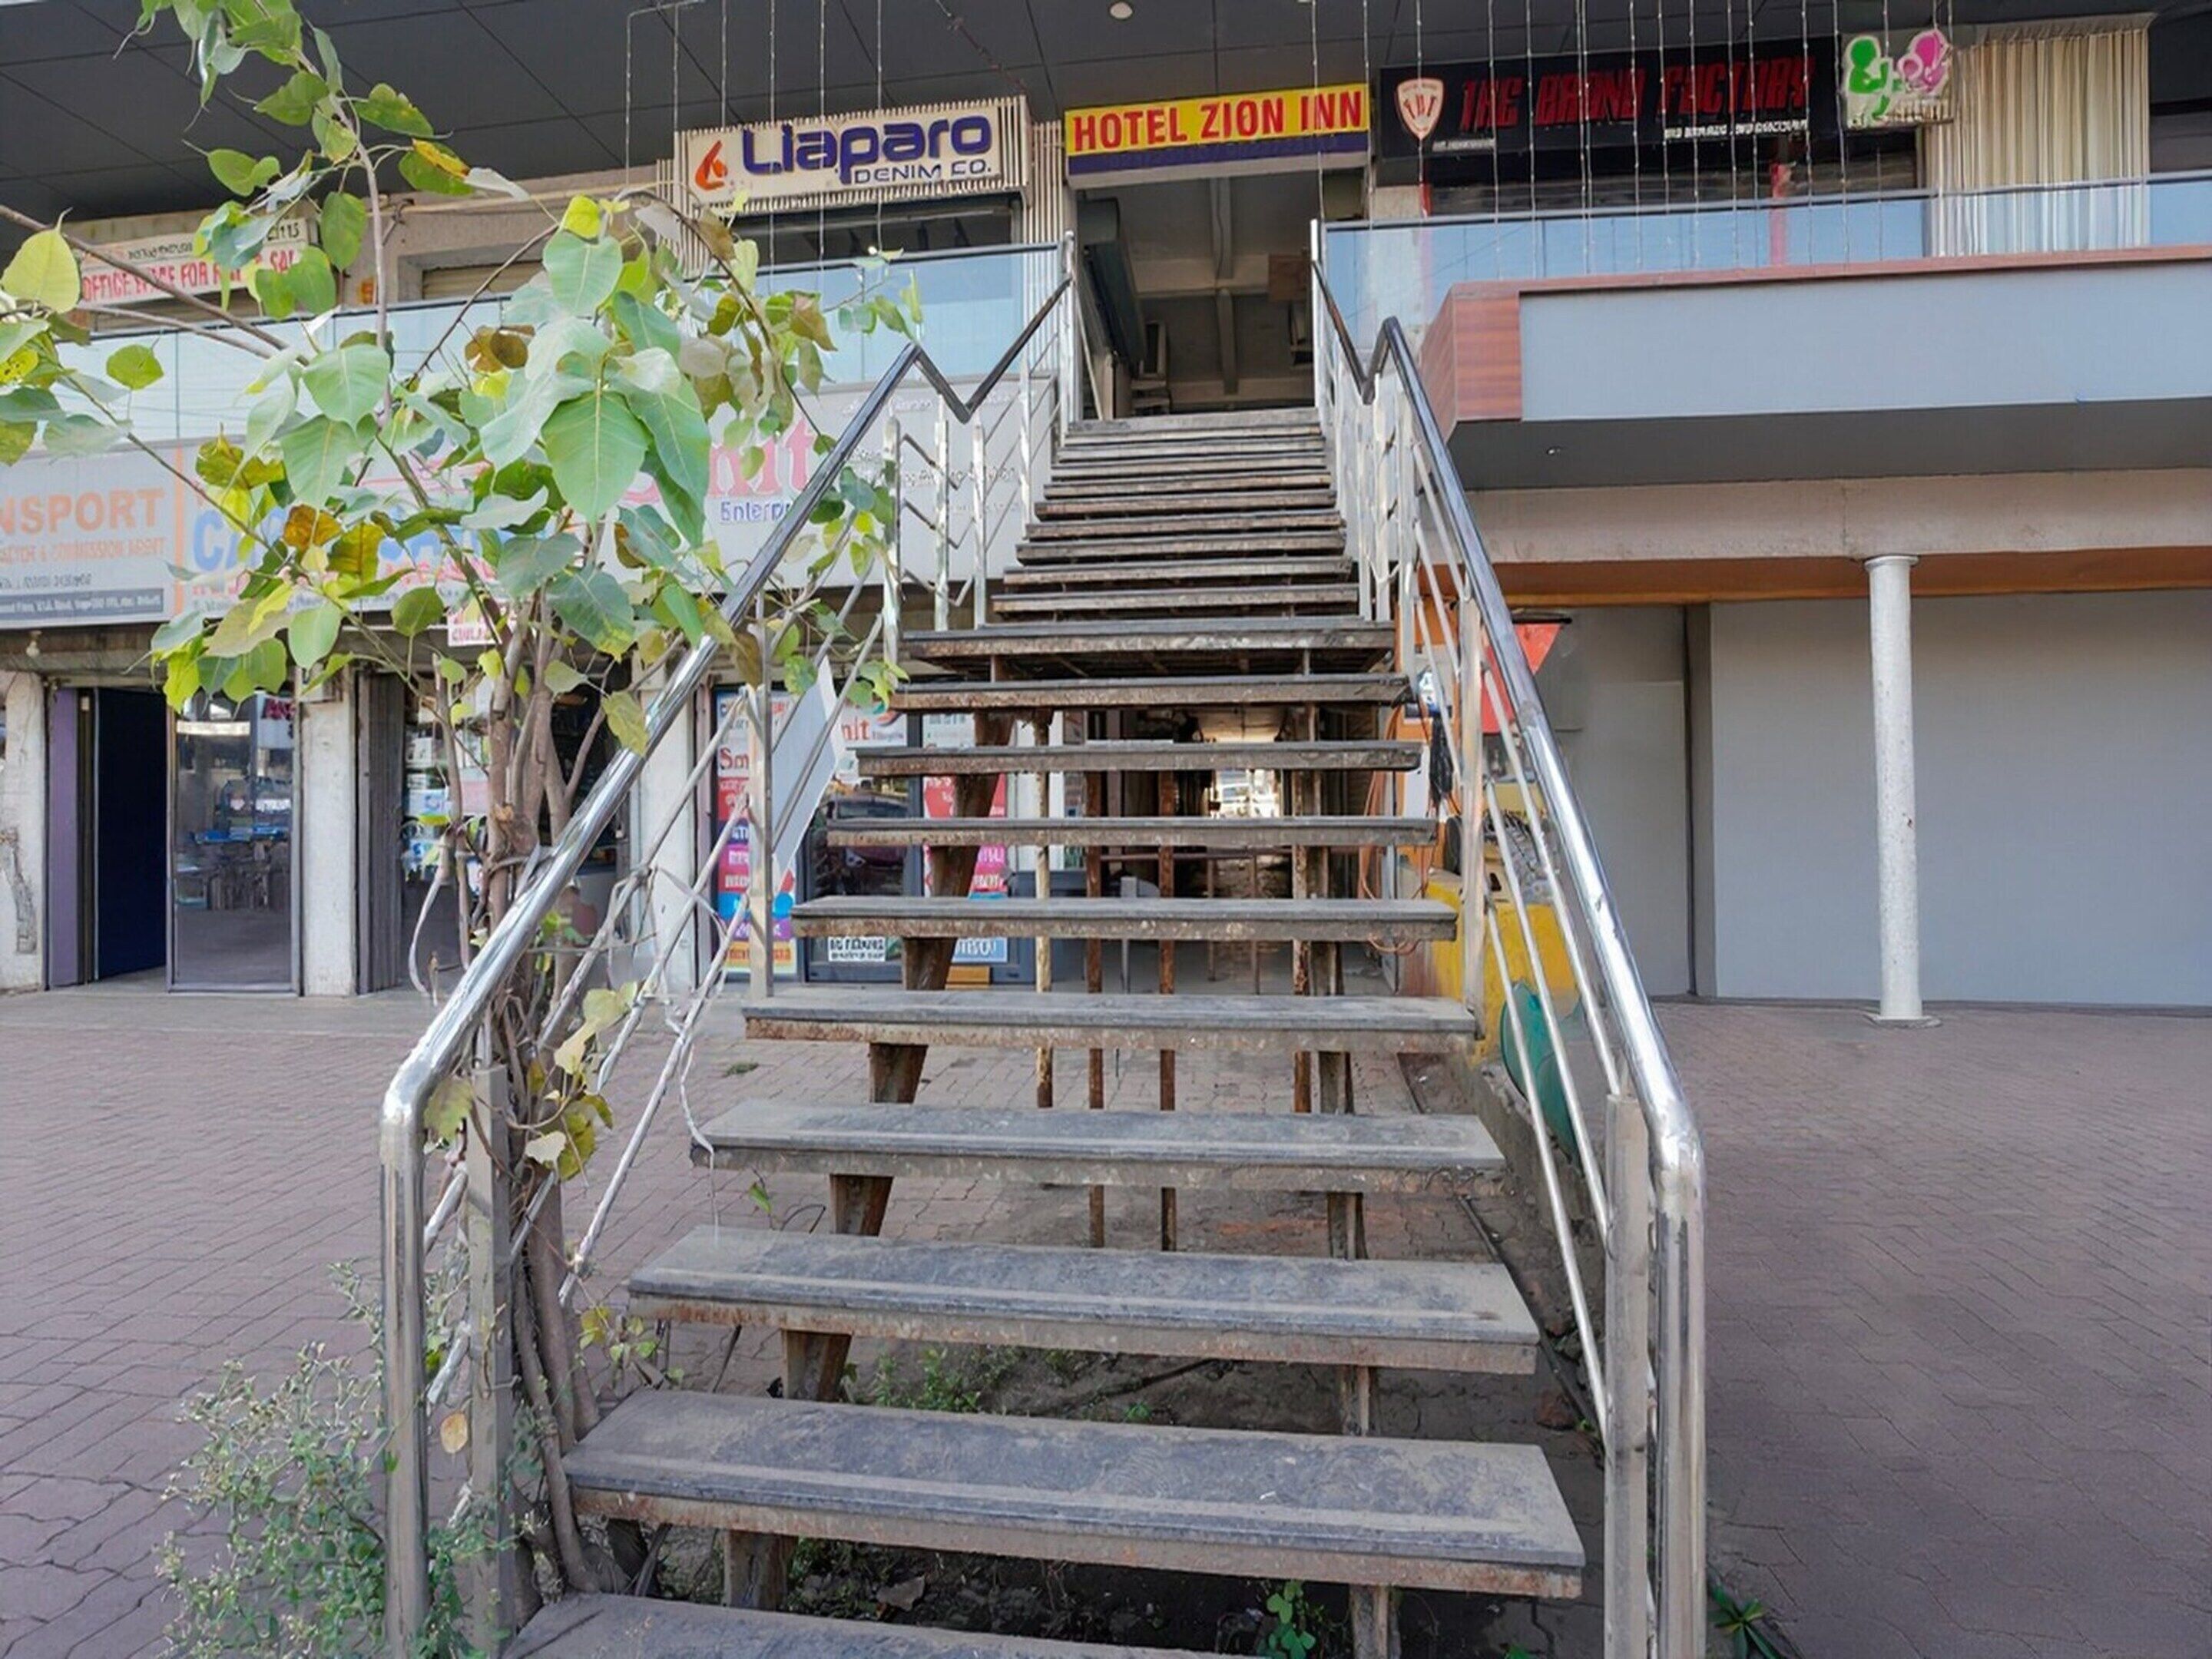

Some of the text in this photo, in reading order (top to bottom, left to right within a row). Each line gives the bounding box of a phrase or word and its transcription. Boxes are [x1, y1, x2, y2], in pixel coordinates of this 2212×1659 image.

[1072, 107, 1188, 152] HOTEL
[1200, 98, 1285, 140] ZION
[1300, 91, 1362, 131] INN
[855, 158, 993, 185] DENIM CO.
[180, 262, 208, 288] FOR
